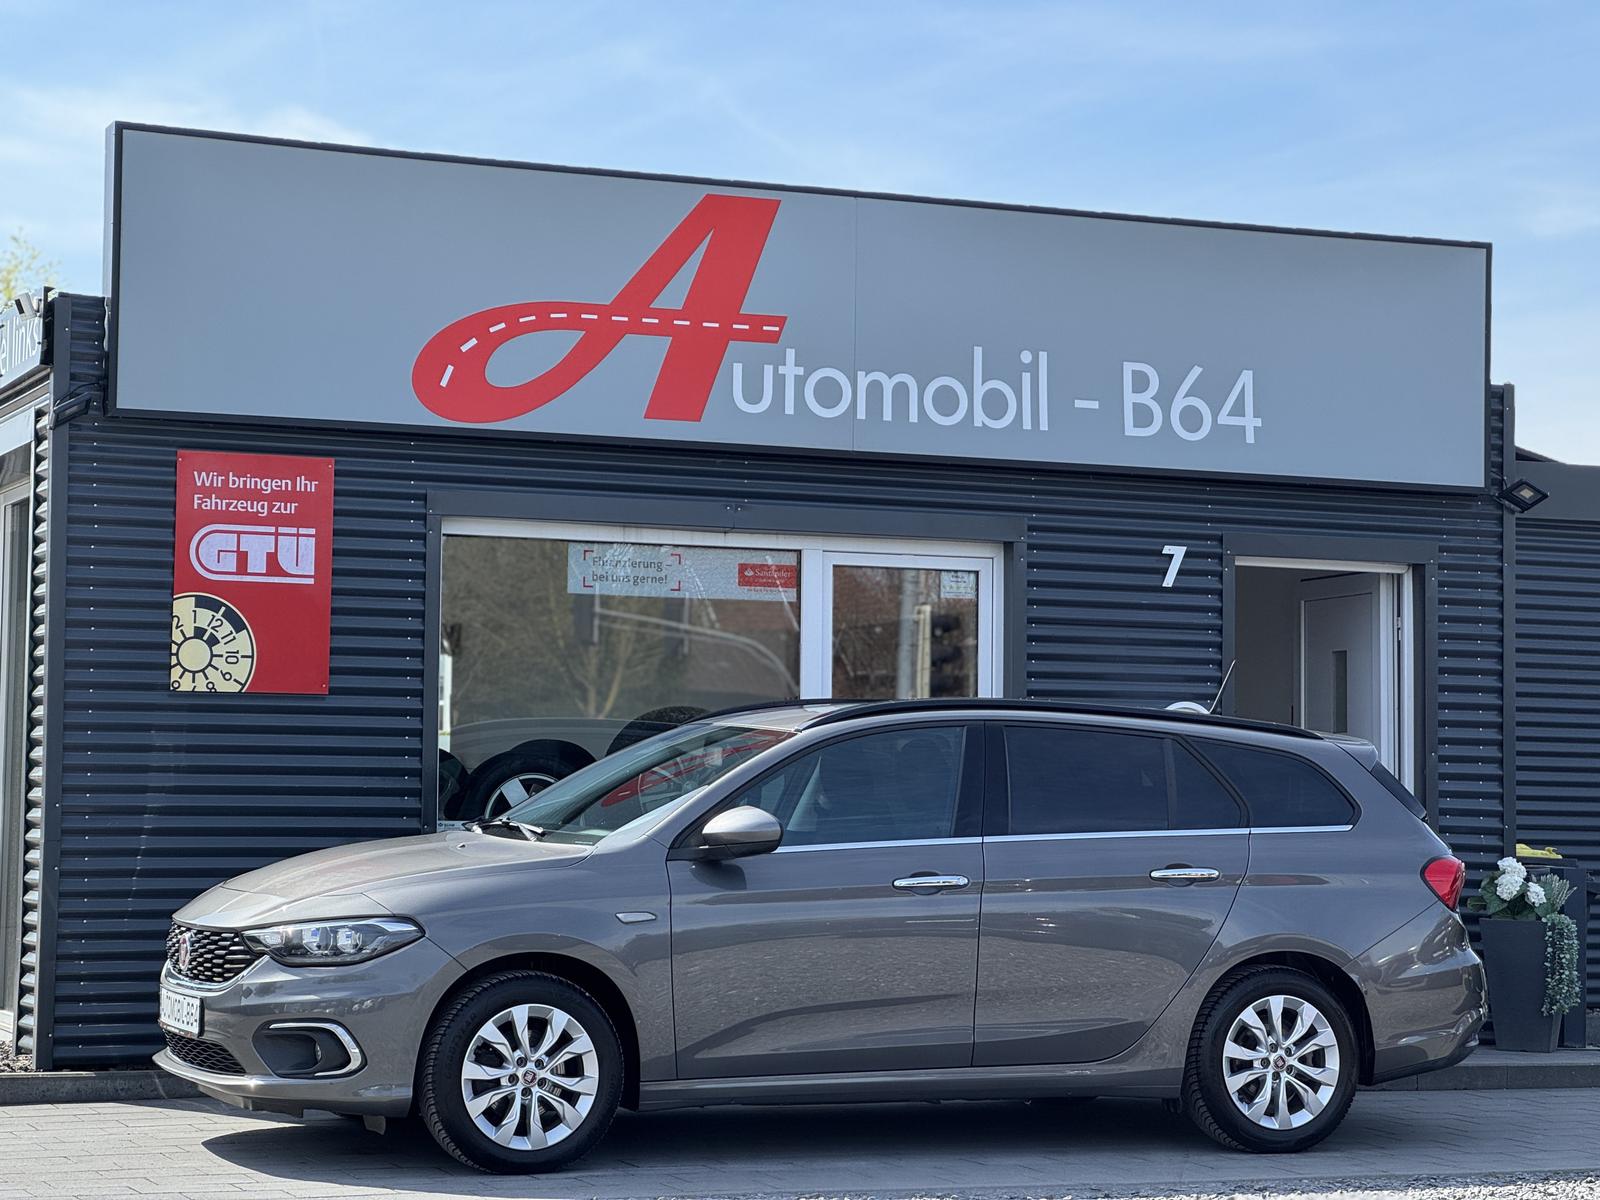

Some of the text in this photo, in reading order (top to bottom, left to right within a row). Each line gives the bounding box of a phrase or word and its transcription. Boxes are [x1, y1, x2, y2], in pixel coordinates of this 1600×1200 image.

[11, 315, 39, 369] links
[1123, 361, 1263, 444] B64
[193, 471, 319, 494] Wir bringen Ihr
[193, 494, 298, 517] Fahrzeug zur
[193, 524, 316, 580] GTÜ
[1161, 545, 1187, 588] 7
[592, 571, 668, 587] bei uns gerne!
[207, 614, 224, 633] 12
[220, 630, 237, 646] 11
[225, 649, 239, 665] 10
